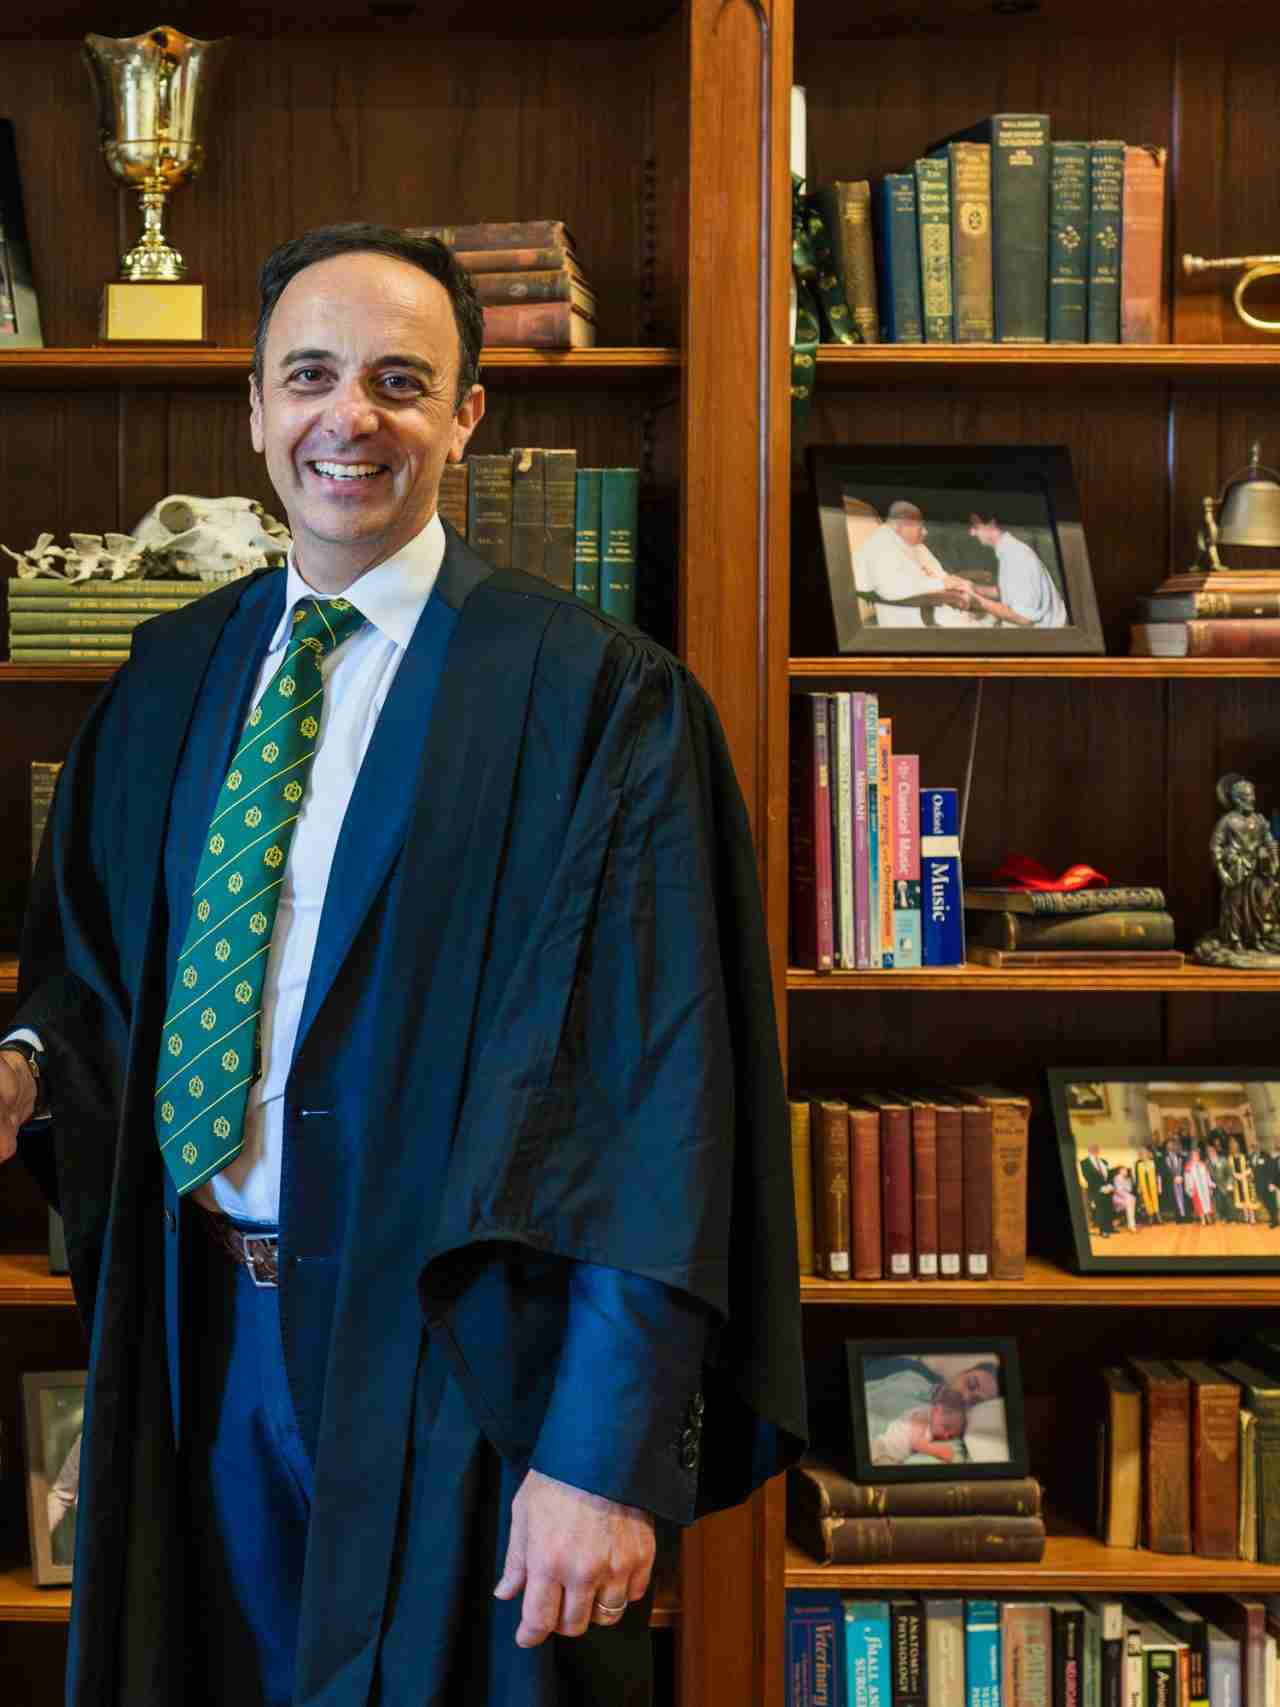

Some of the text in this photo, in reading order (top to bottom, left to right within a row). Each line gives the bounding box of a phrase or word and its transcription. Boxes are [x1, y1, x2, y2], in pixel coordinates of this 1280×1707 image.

[897, 782, 910, 834] Classical
[932, 793, 943, 835] Oxford
[897, 837, 910, 875] Music
[931, 863, 951, 922] Music
[898, 1616, 907, 1693] PHYSIOLOGY
[910, 1616, 919, 1675] ANATOMY
